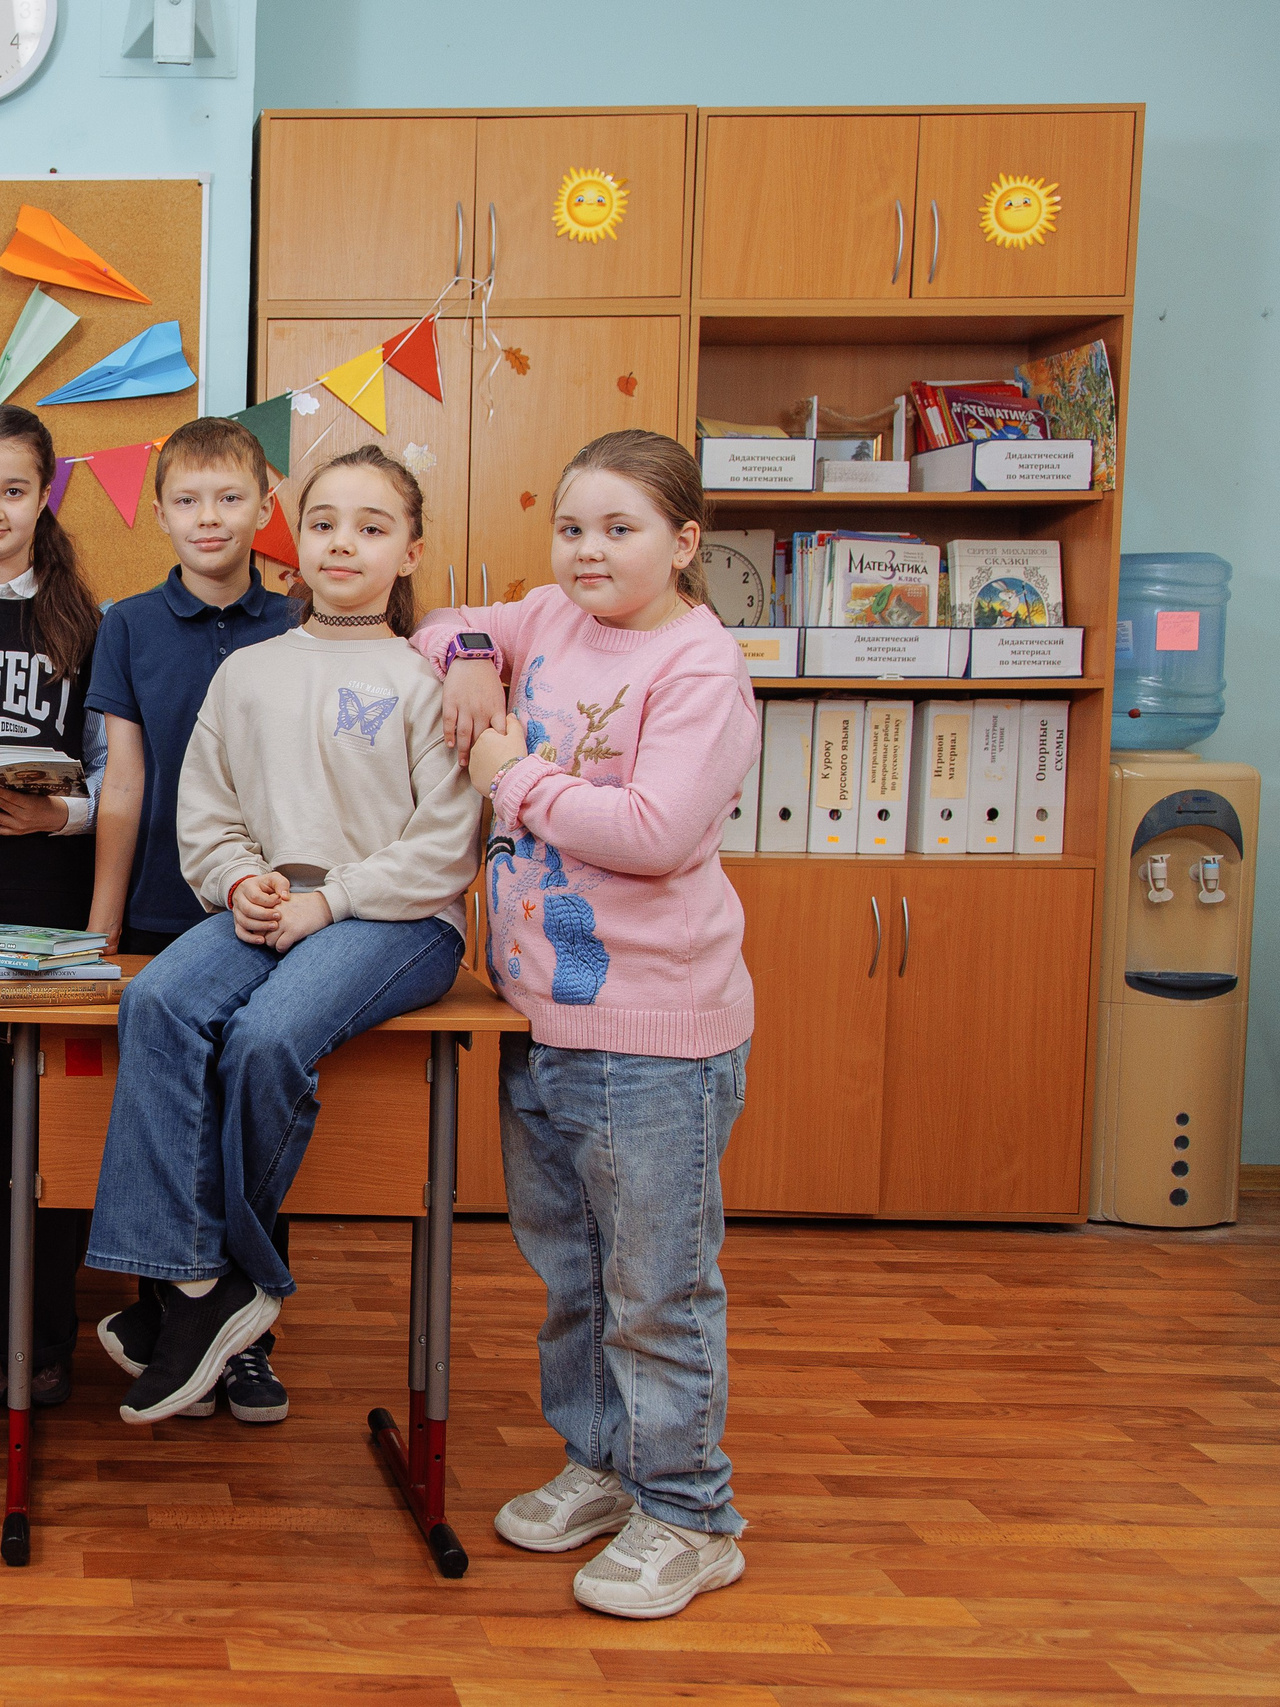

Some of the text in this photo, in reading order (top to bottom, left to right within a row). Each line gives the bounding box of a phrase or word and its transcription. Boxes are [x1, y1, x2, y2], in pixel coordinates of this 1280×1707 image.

[10, 32, 21, 50] 4
[951, 401, 1038, 422] МАТЕМАТИКА
[728, 453, 796, 462] Дидактический
[1004, 451, 1075, 461] Дидактический
[741, 465, 783, 473] материал
[1017, 462, 1061, 471] материал
[966, 547, 1048, 555] СЕРГЕЙ МИХАЛКОВ
[726, 556, 732, 568] 1
[881, 549, 897, 580] 3
[984, 557, 1029, 566] СКАЗКИ
[742, 571, 750, 584] 2
[897, 575, 922, 583] класс
[747, 595, 755, 608] 3
[854, 634, 919, 643] Дидактический
[997, 638, 1064, 647] Дидактический
[866, 646, 906, 654] материал
[1010, 648, 1051, 656] материал
[347, 680, 366, 689] STAY
[0, 720, 28, 734] DECISION
[880, 713, 891, 795] проверочные работы
[890, 718, 902, 791] по русскому языку
[934, 734, 945, 778] Игровой
[948, 732, 958, 780] материал
[1035, 719, 1050, 782] Опорные
[1054, 728, 1065, 772] схемы
[821, 740, 834, 780] К уроку
[839, 719, 850, 801] русского языка
[871, 731, 880, 784] контрольные
